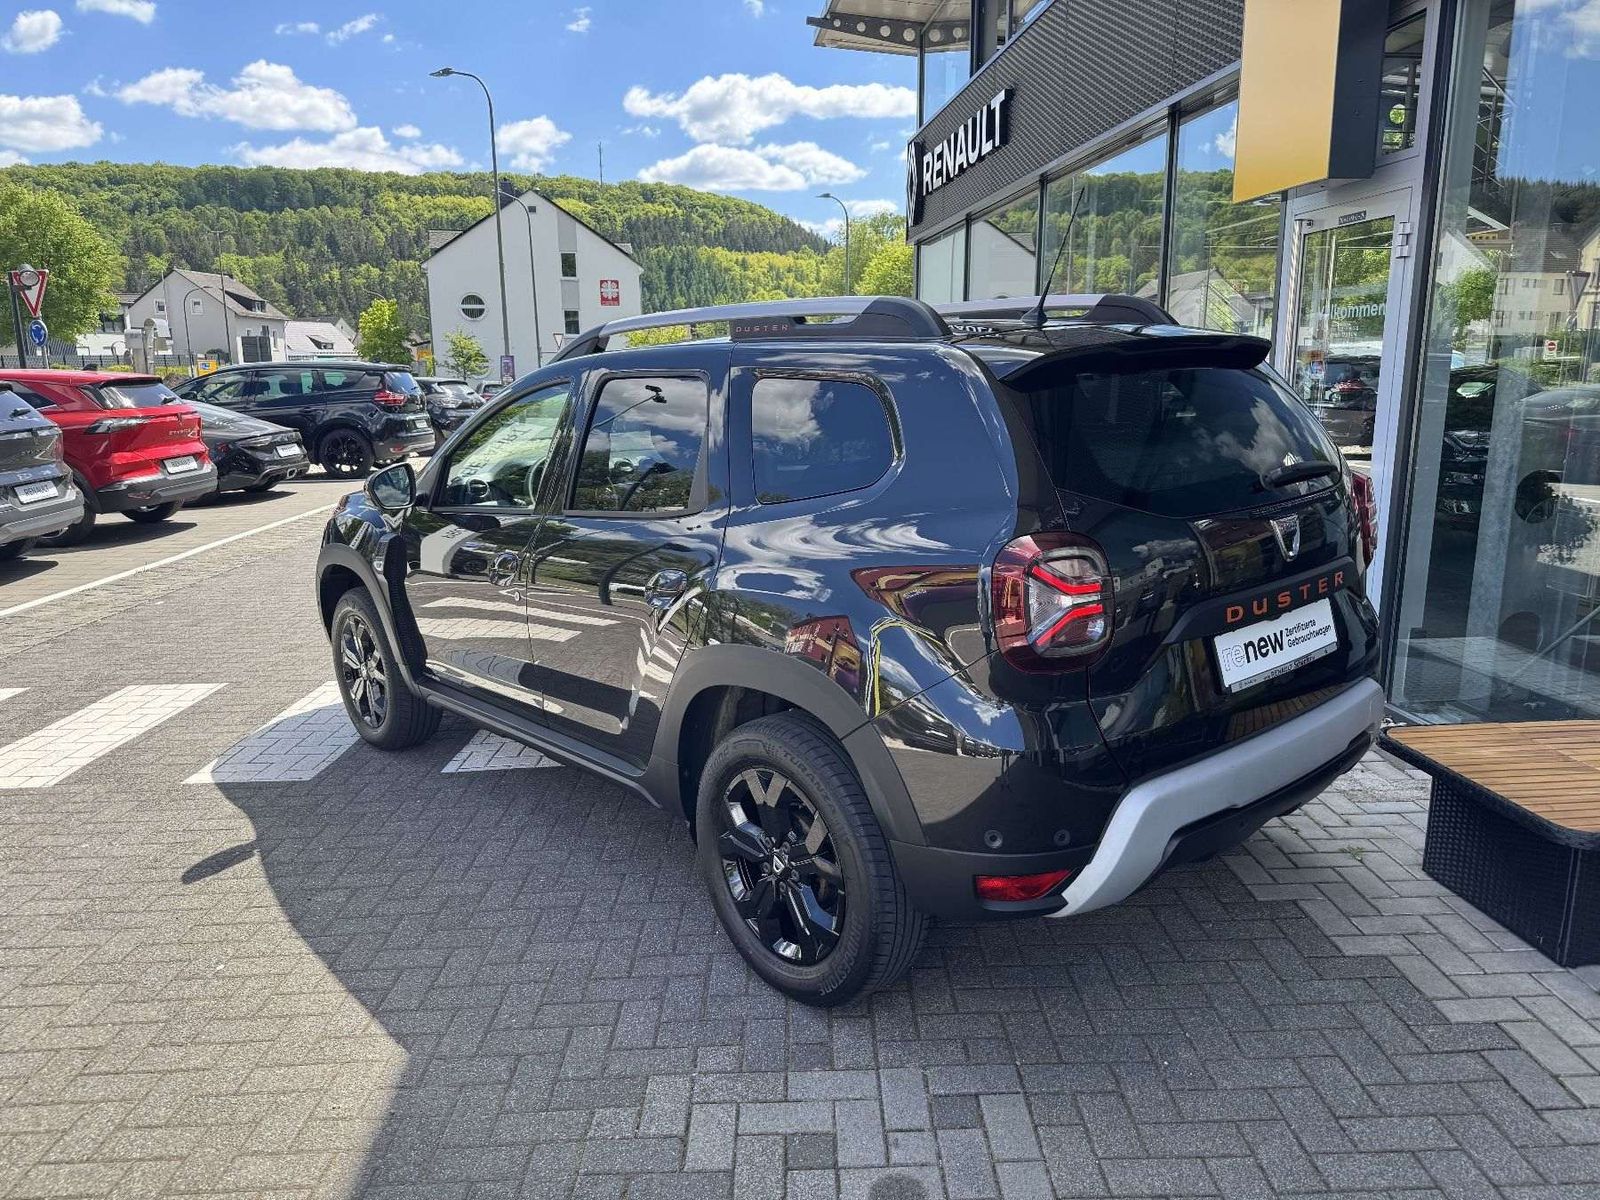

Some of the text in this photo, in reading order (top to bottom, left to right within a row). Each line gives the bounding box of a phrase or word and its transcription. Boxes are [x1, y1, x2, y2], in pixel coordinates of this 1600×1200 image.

[923, 88, 1006, 196] RENAULT
[736, 324, 788, 333] DUSTER
[1226, 570, 1345, 623] DUSTER
[1285, 618, 1317, 637] Zertifizierte
[1287, 625, 1332, 648] Gebrauchtwagen
[1222, 630, 1284, 672] renew
